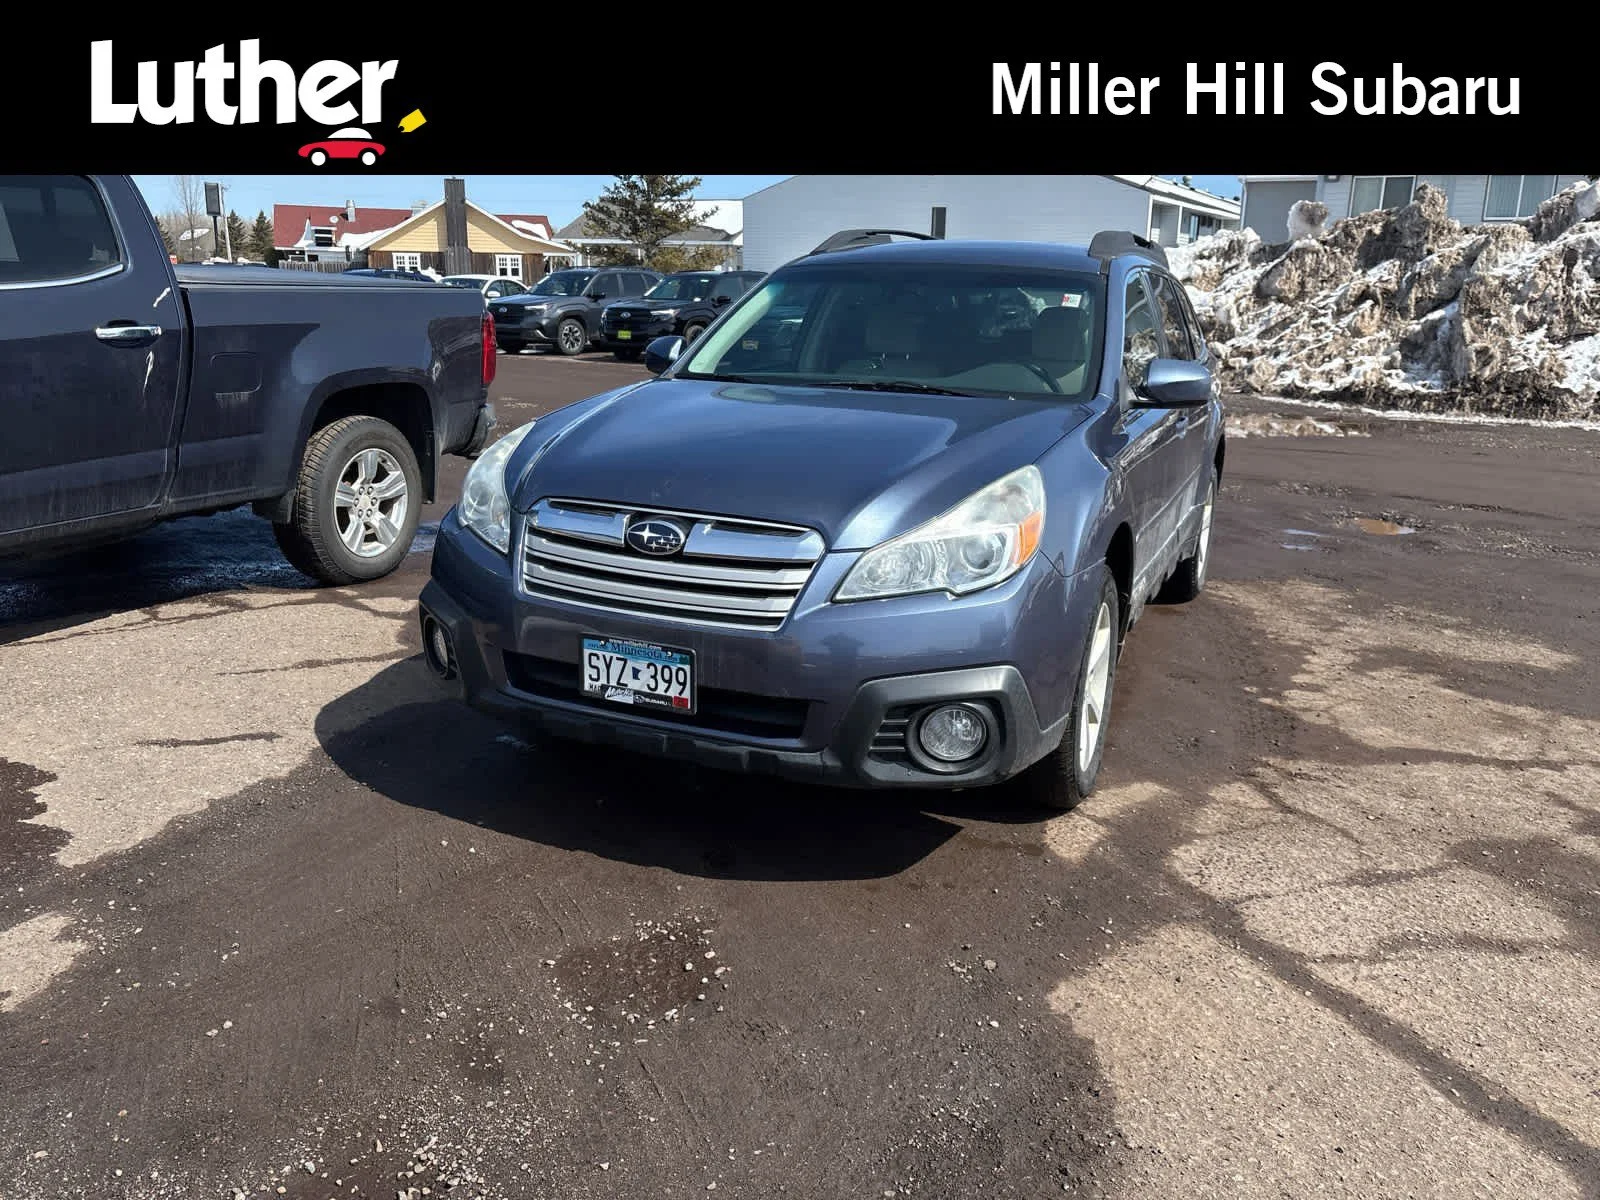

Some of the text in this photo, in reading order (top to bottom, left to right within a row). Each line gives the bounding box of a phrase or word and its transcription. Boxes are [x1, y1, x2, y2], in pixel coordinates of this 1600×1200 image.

[610, 643, 663, 659] Minnesota
[588, 652, 688, 697] SYZ 399
